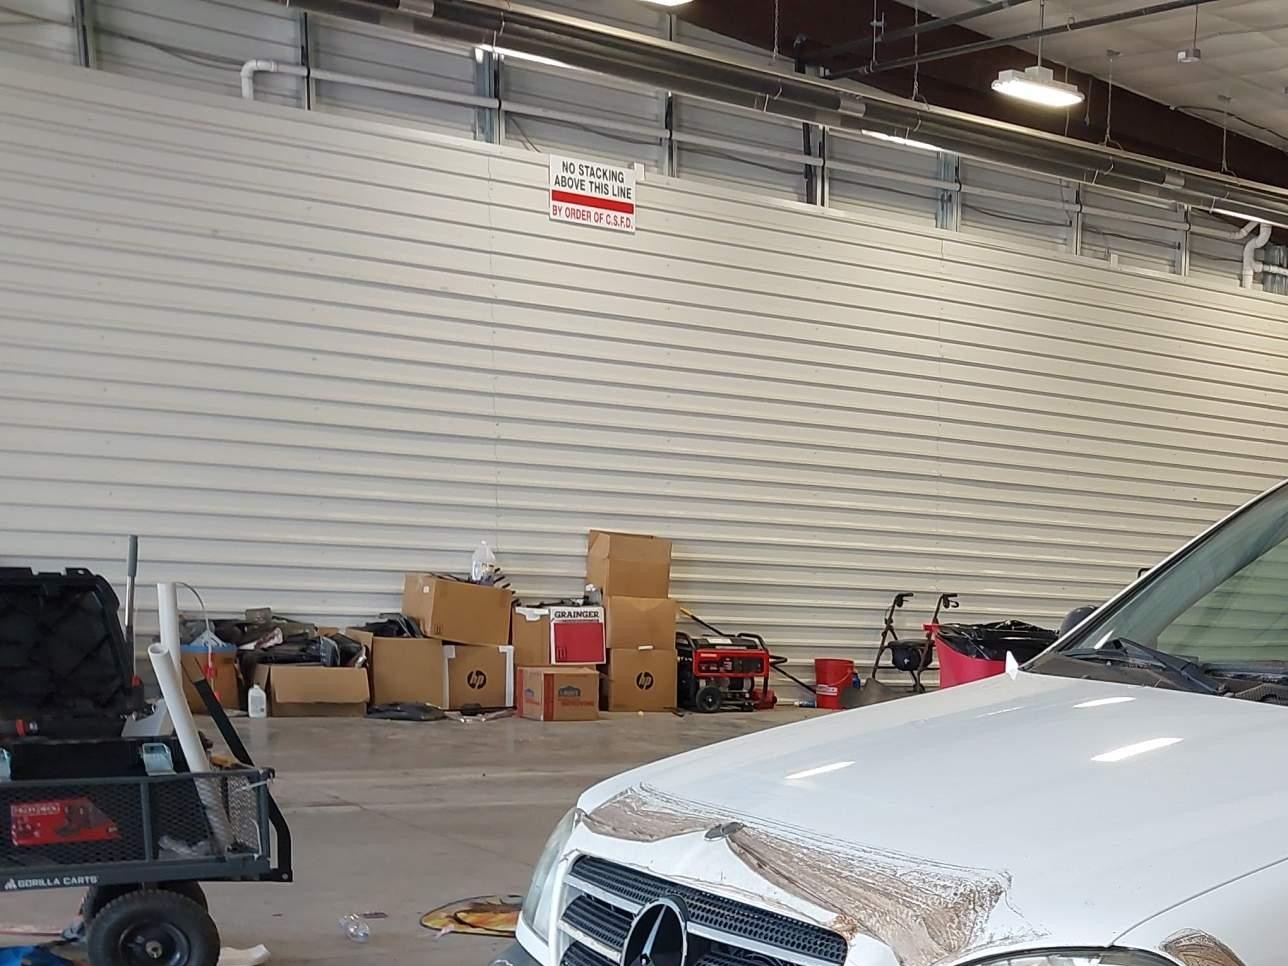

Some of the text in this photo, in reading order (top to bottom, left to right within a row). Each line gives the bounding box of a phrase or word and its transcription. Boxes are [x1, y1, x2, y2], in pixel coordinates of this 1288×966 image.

[562, 160, 625, 184] NO STACKING
[554, 174, 632, 200] ABOVE THIS LINE
[552, 204, 634, 230] BY ORDER OF C.S.F.D.
[554, 610, 600, 619] GRAINGER
[467, 670, 487, 689] hp
[636, 671, 654, 690] hp
[17, 878, 61, 888] GORILLA
